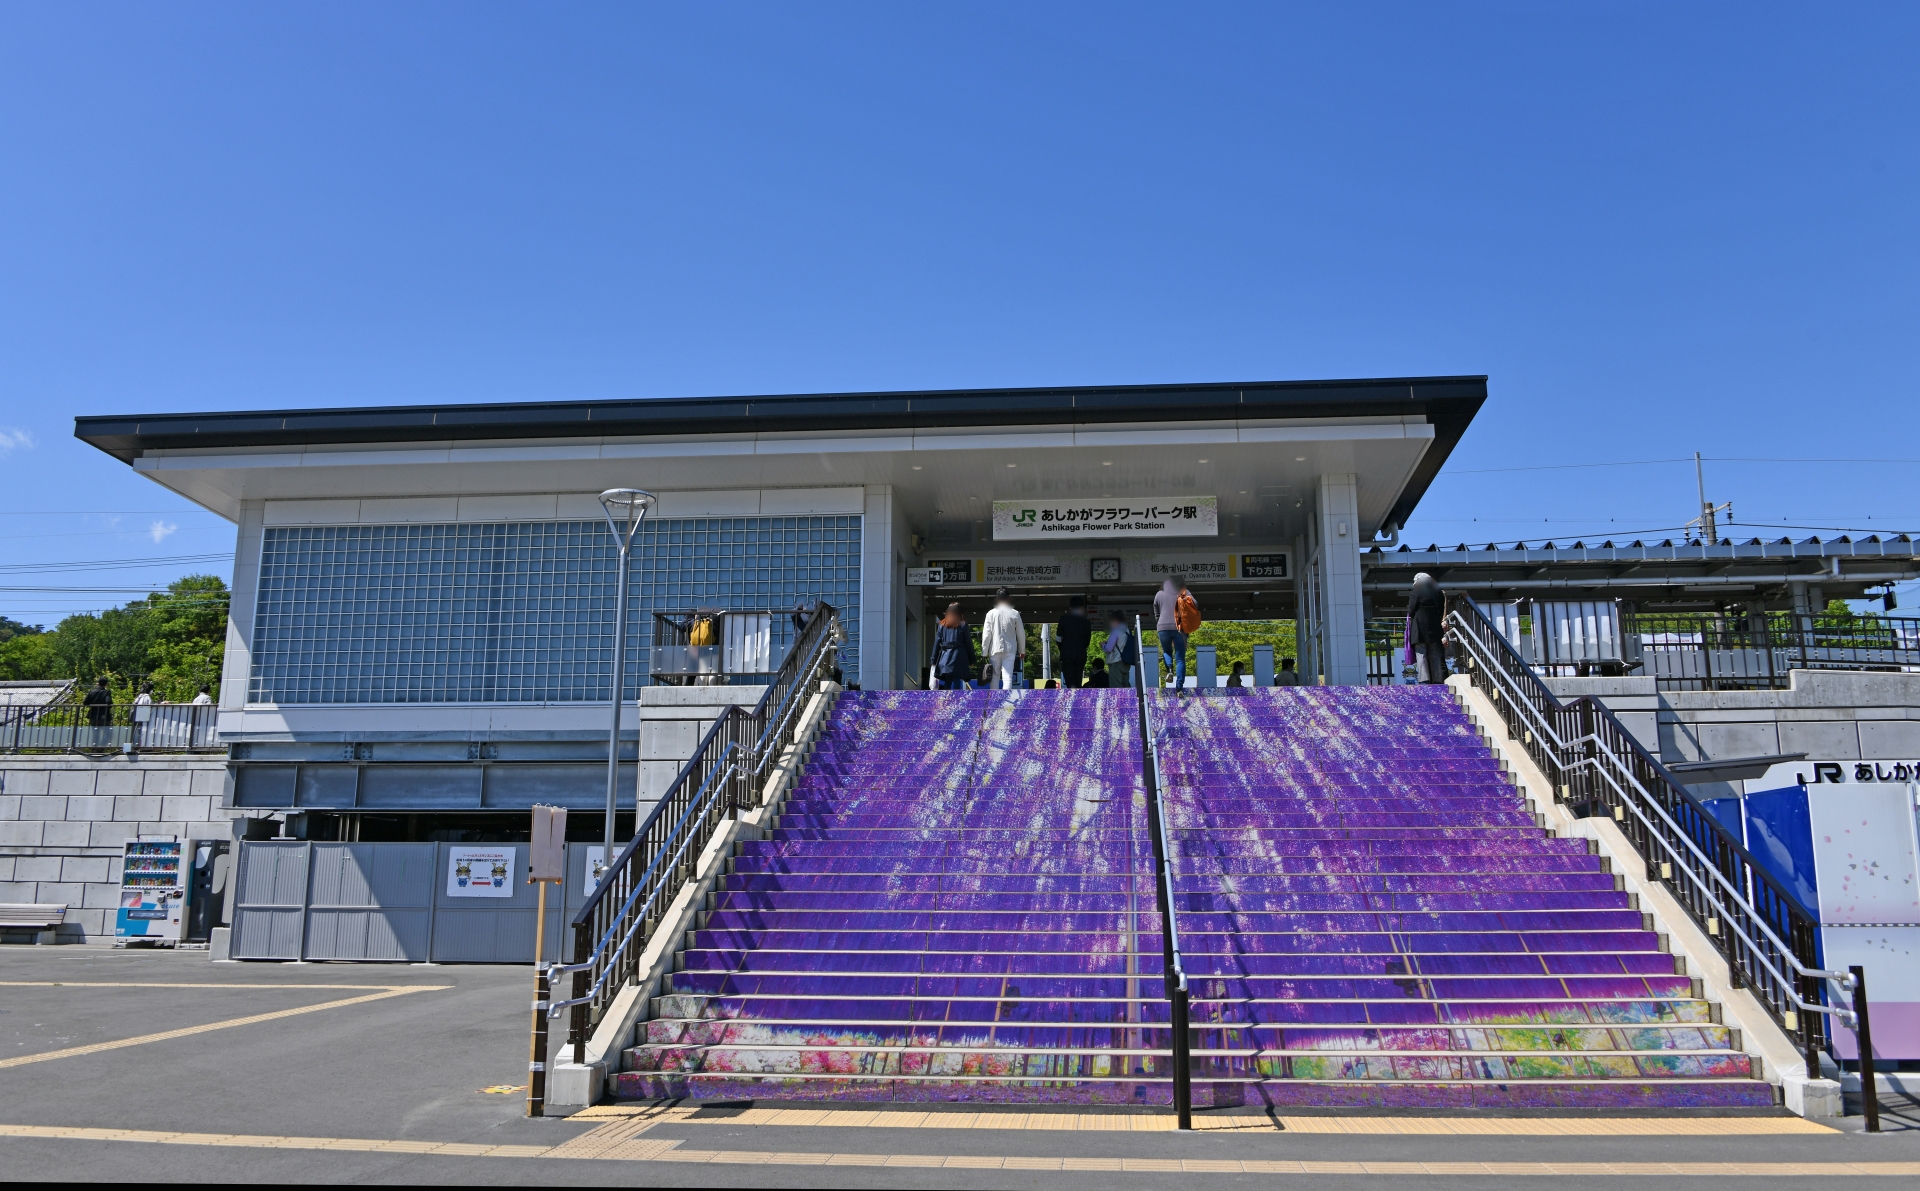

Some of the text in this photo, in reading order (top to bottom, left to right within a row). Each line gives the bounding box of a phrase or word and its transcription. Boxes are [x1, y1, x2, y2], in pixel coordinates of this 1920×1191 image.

[1012, 509, 1037, 523] JR
[1041, 506, 1197, 521] あしかがフラワーパーク駅
[1041, 522, 1165, 532] Ashikaga Flower Park Station
[1246, 566, 1283, 576] 下り方面
[1796, 762, 1841, 784] JR
